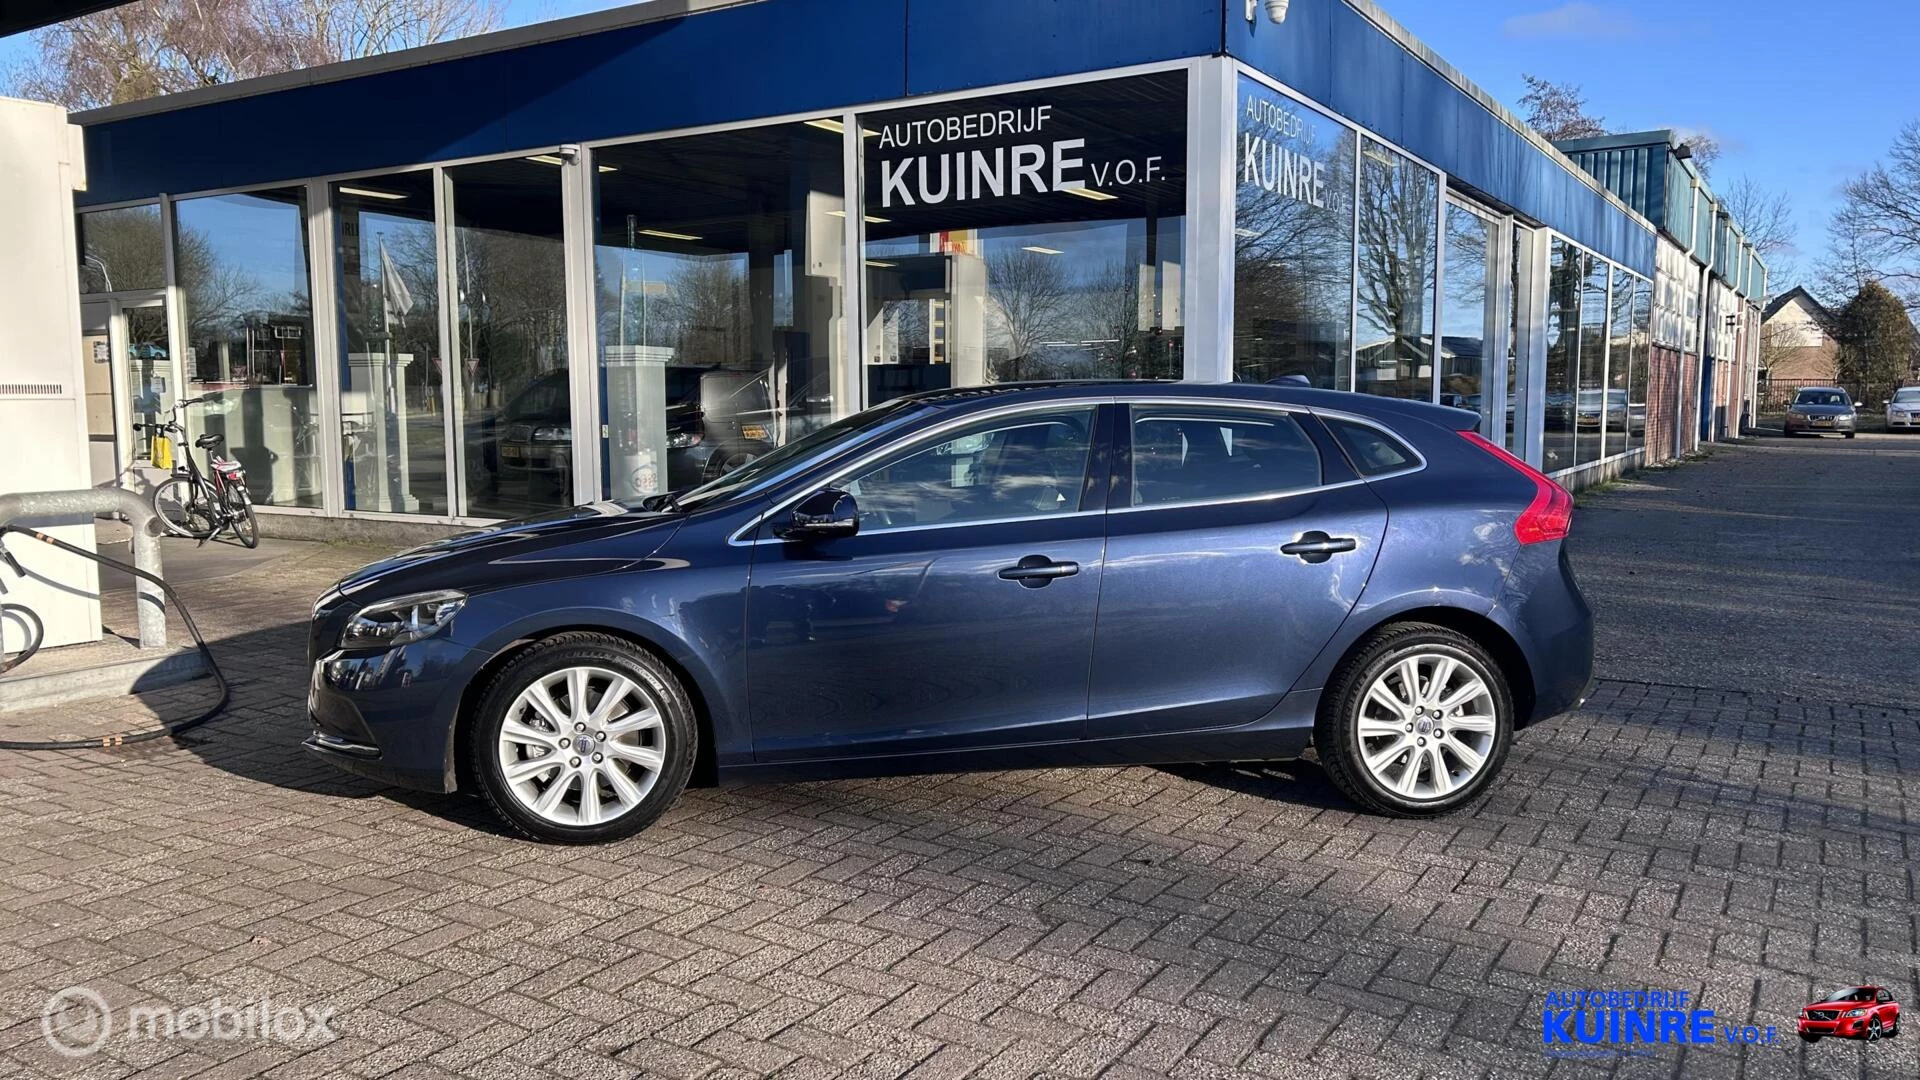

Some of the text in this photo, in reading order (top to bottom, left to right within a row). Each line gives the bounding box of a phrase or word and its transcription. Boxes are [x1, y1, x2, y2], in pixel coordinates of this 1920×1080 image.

[879, 105, 1051, 149] AUTOBEDRIJF
[1246, 95, 1317, 145] AUTOBEDRIJF
[881, 138, 1166, 208] KUINRE V.O.F.
[1244, 132, 1325, 209] KUINRE
